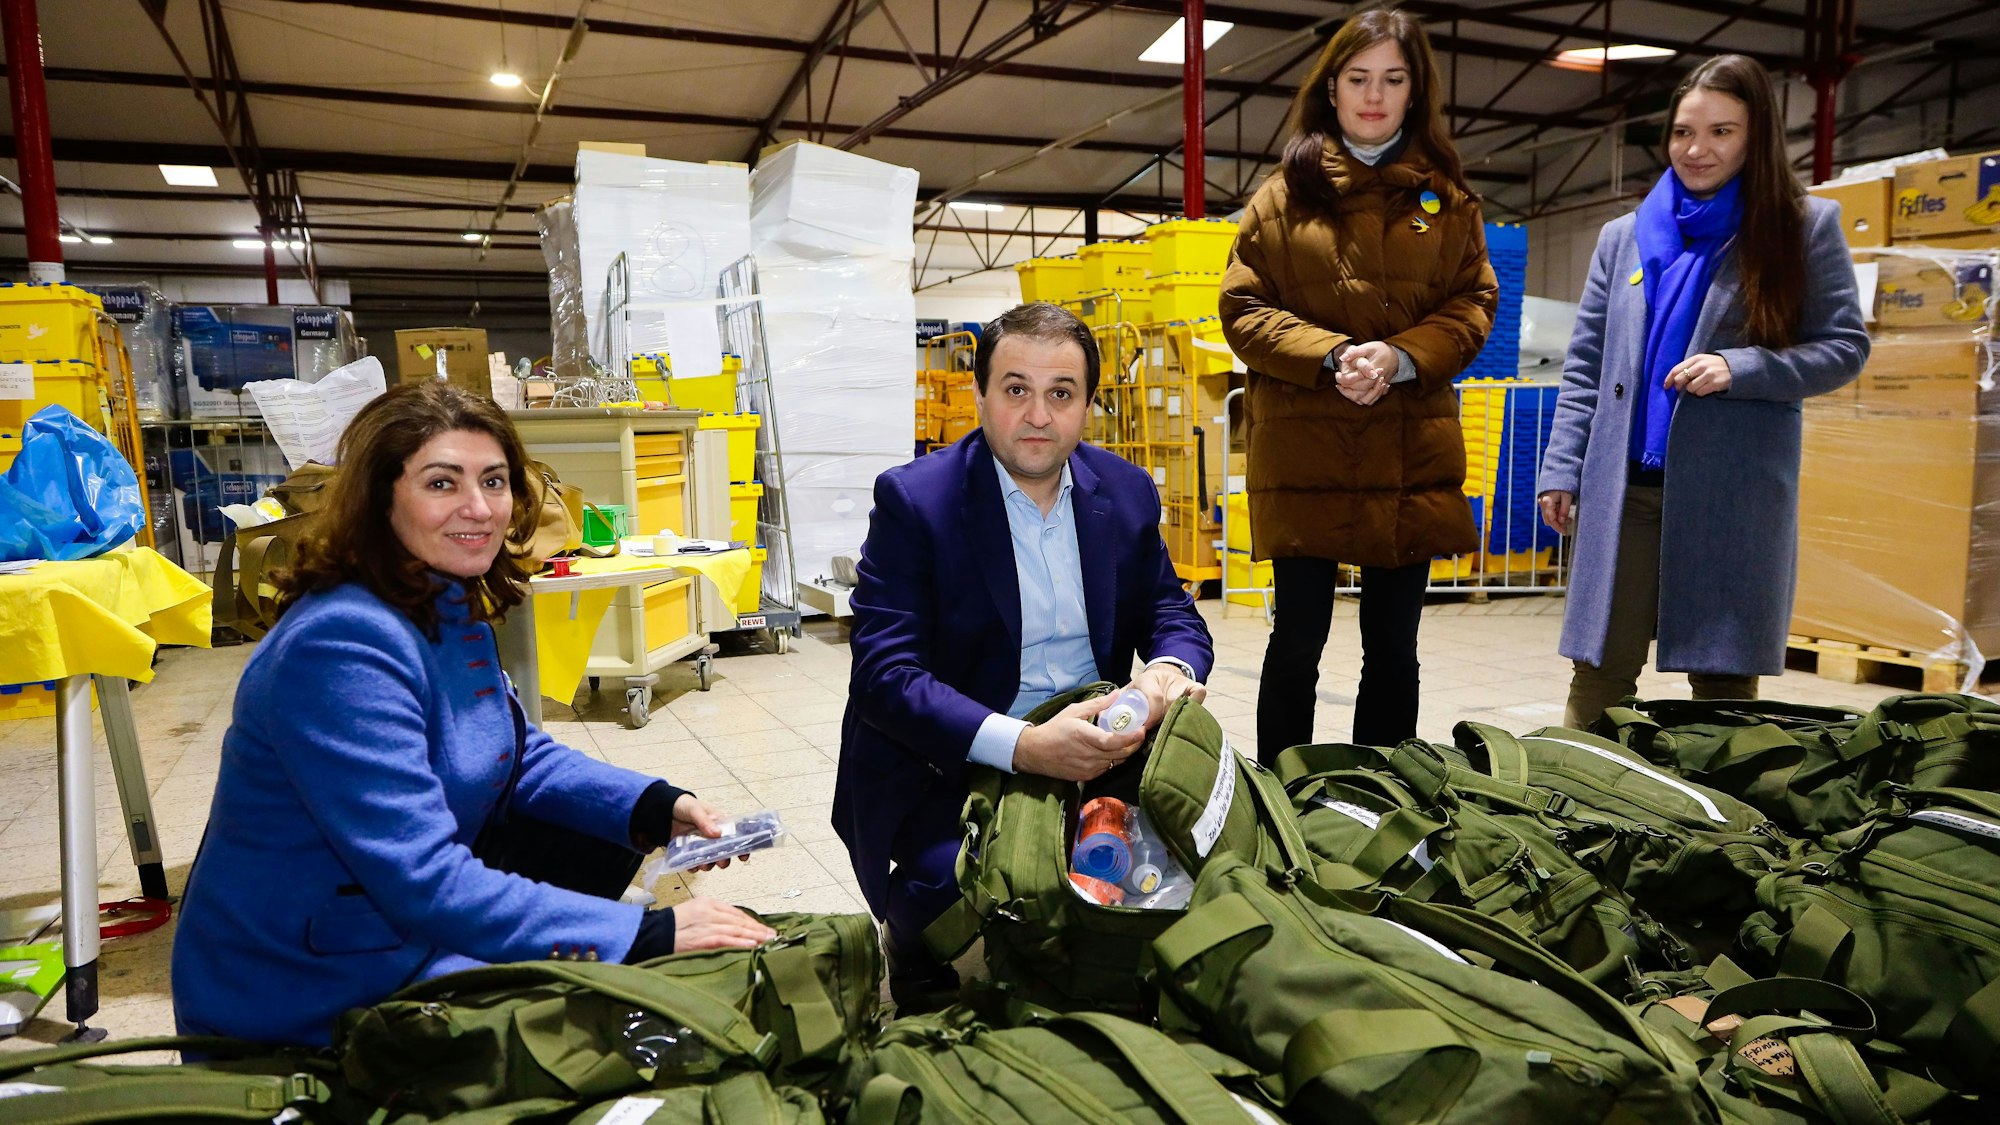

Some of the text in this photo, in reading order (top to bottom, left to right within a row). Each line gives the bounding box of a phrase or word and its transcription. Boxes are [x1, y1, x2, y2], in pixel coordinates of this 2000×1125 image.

[101, 290, 141, 309] cheppach
[300, 329, 329, 338] Germany
[741, 617, 765, 627] REWE
